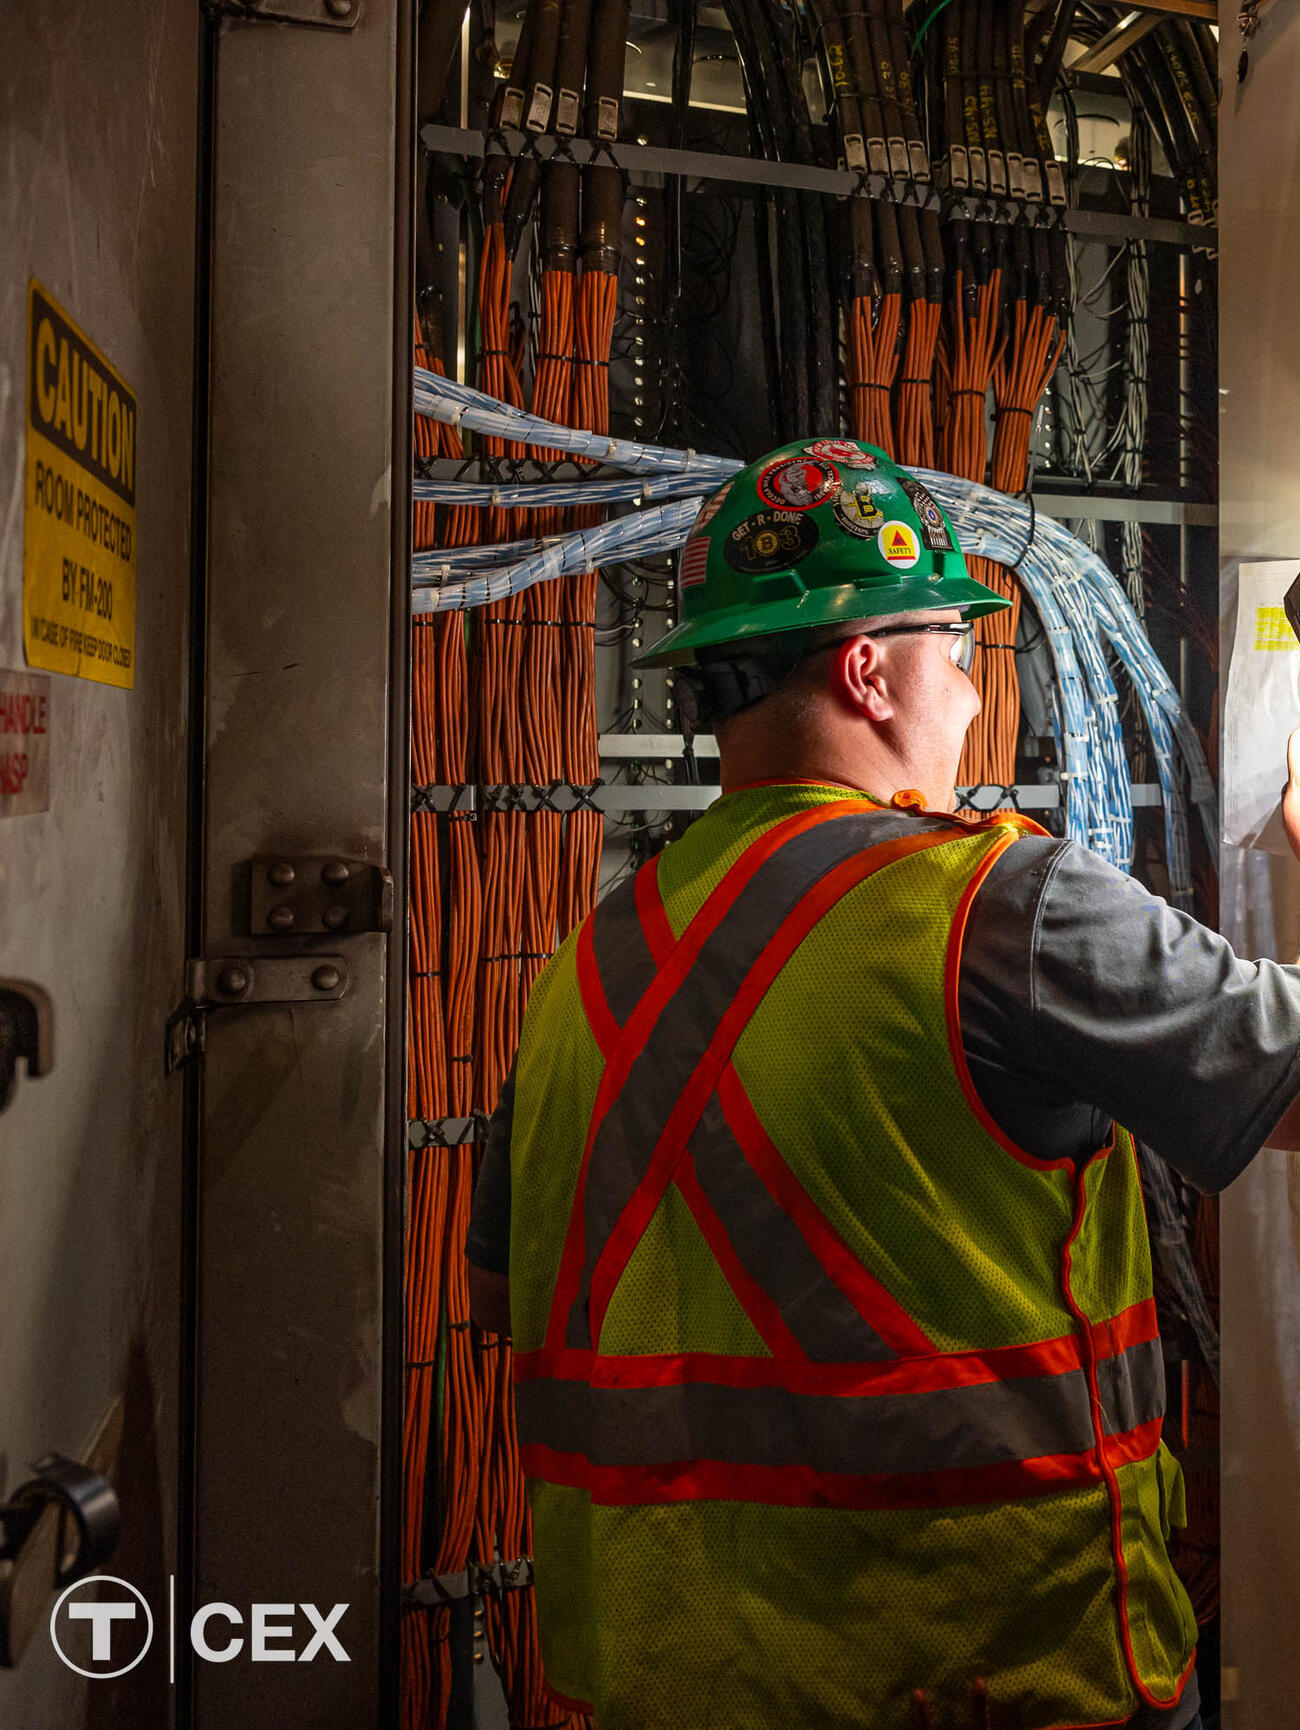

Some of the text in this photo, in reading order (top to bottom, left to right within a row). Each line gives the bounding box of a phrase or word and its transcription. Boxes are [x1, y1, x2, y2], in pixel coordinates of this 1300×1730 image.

[36, 316, 135, 491] CAUTION
[34, 459, 133, 563] ROOM PROTECTED
[887, 547, 912, 556] SAFETY
[62, 556, 114, 624] BY FM-200
